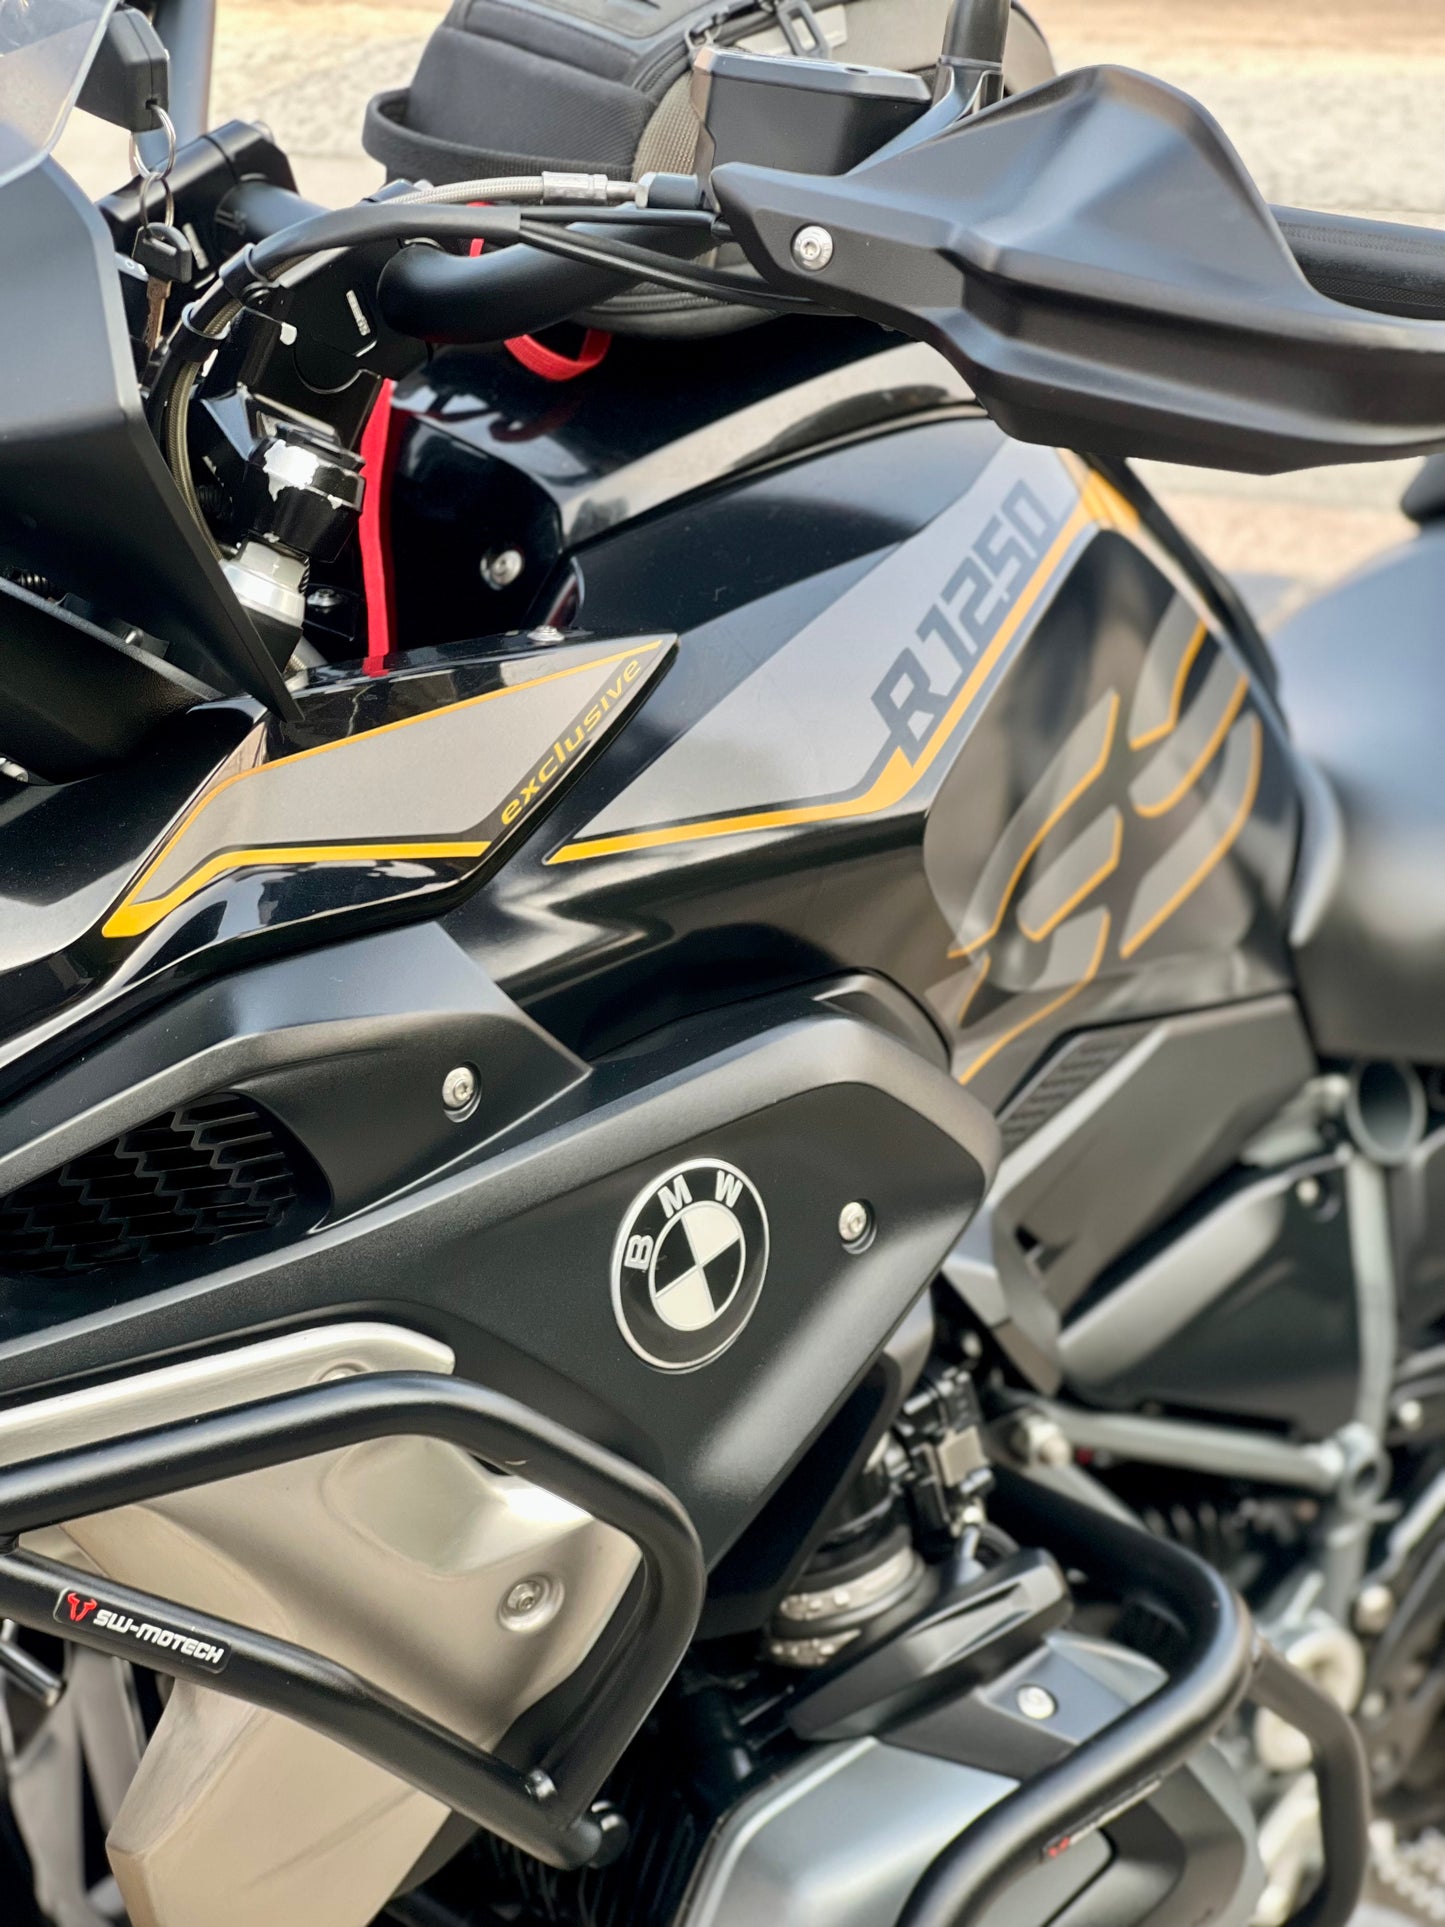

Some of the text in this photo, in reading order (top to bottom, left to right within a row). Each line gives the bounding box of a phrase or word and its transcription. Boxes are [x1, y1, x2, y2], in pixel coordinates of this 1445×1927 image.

[870, 478, 1054, 750] R1250
[500, 658, 642, 826] exclusive
[623, 1168, 744, 1272] BMW
[92, 1608, 226, 1664] SW-MOTECH
